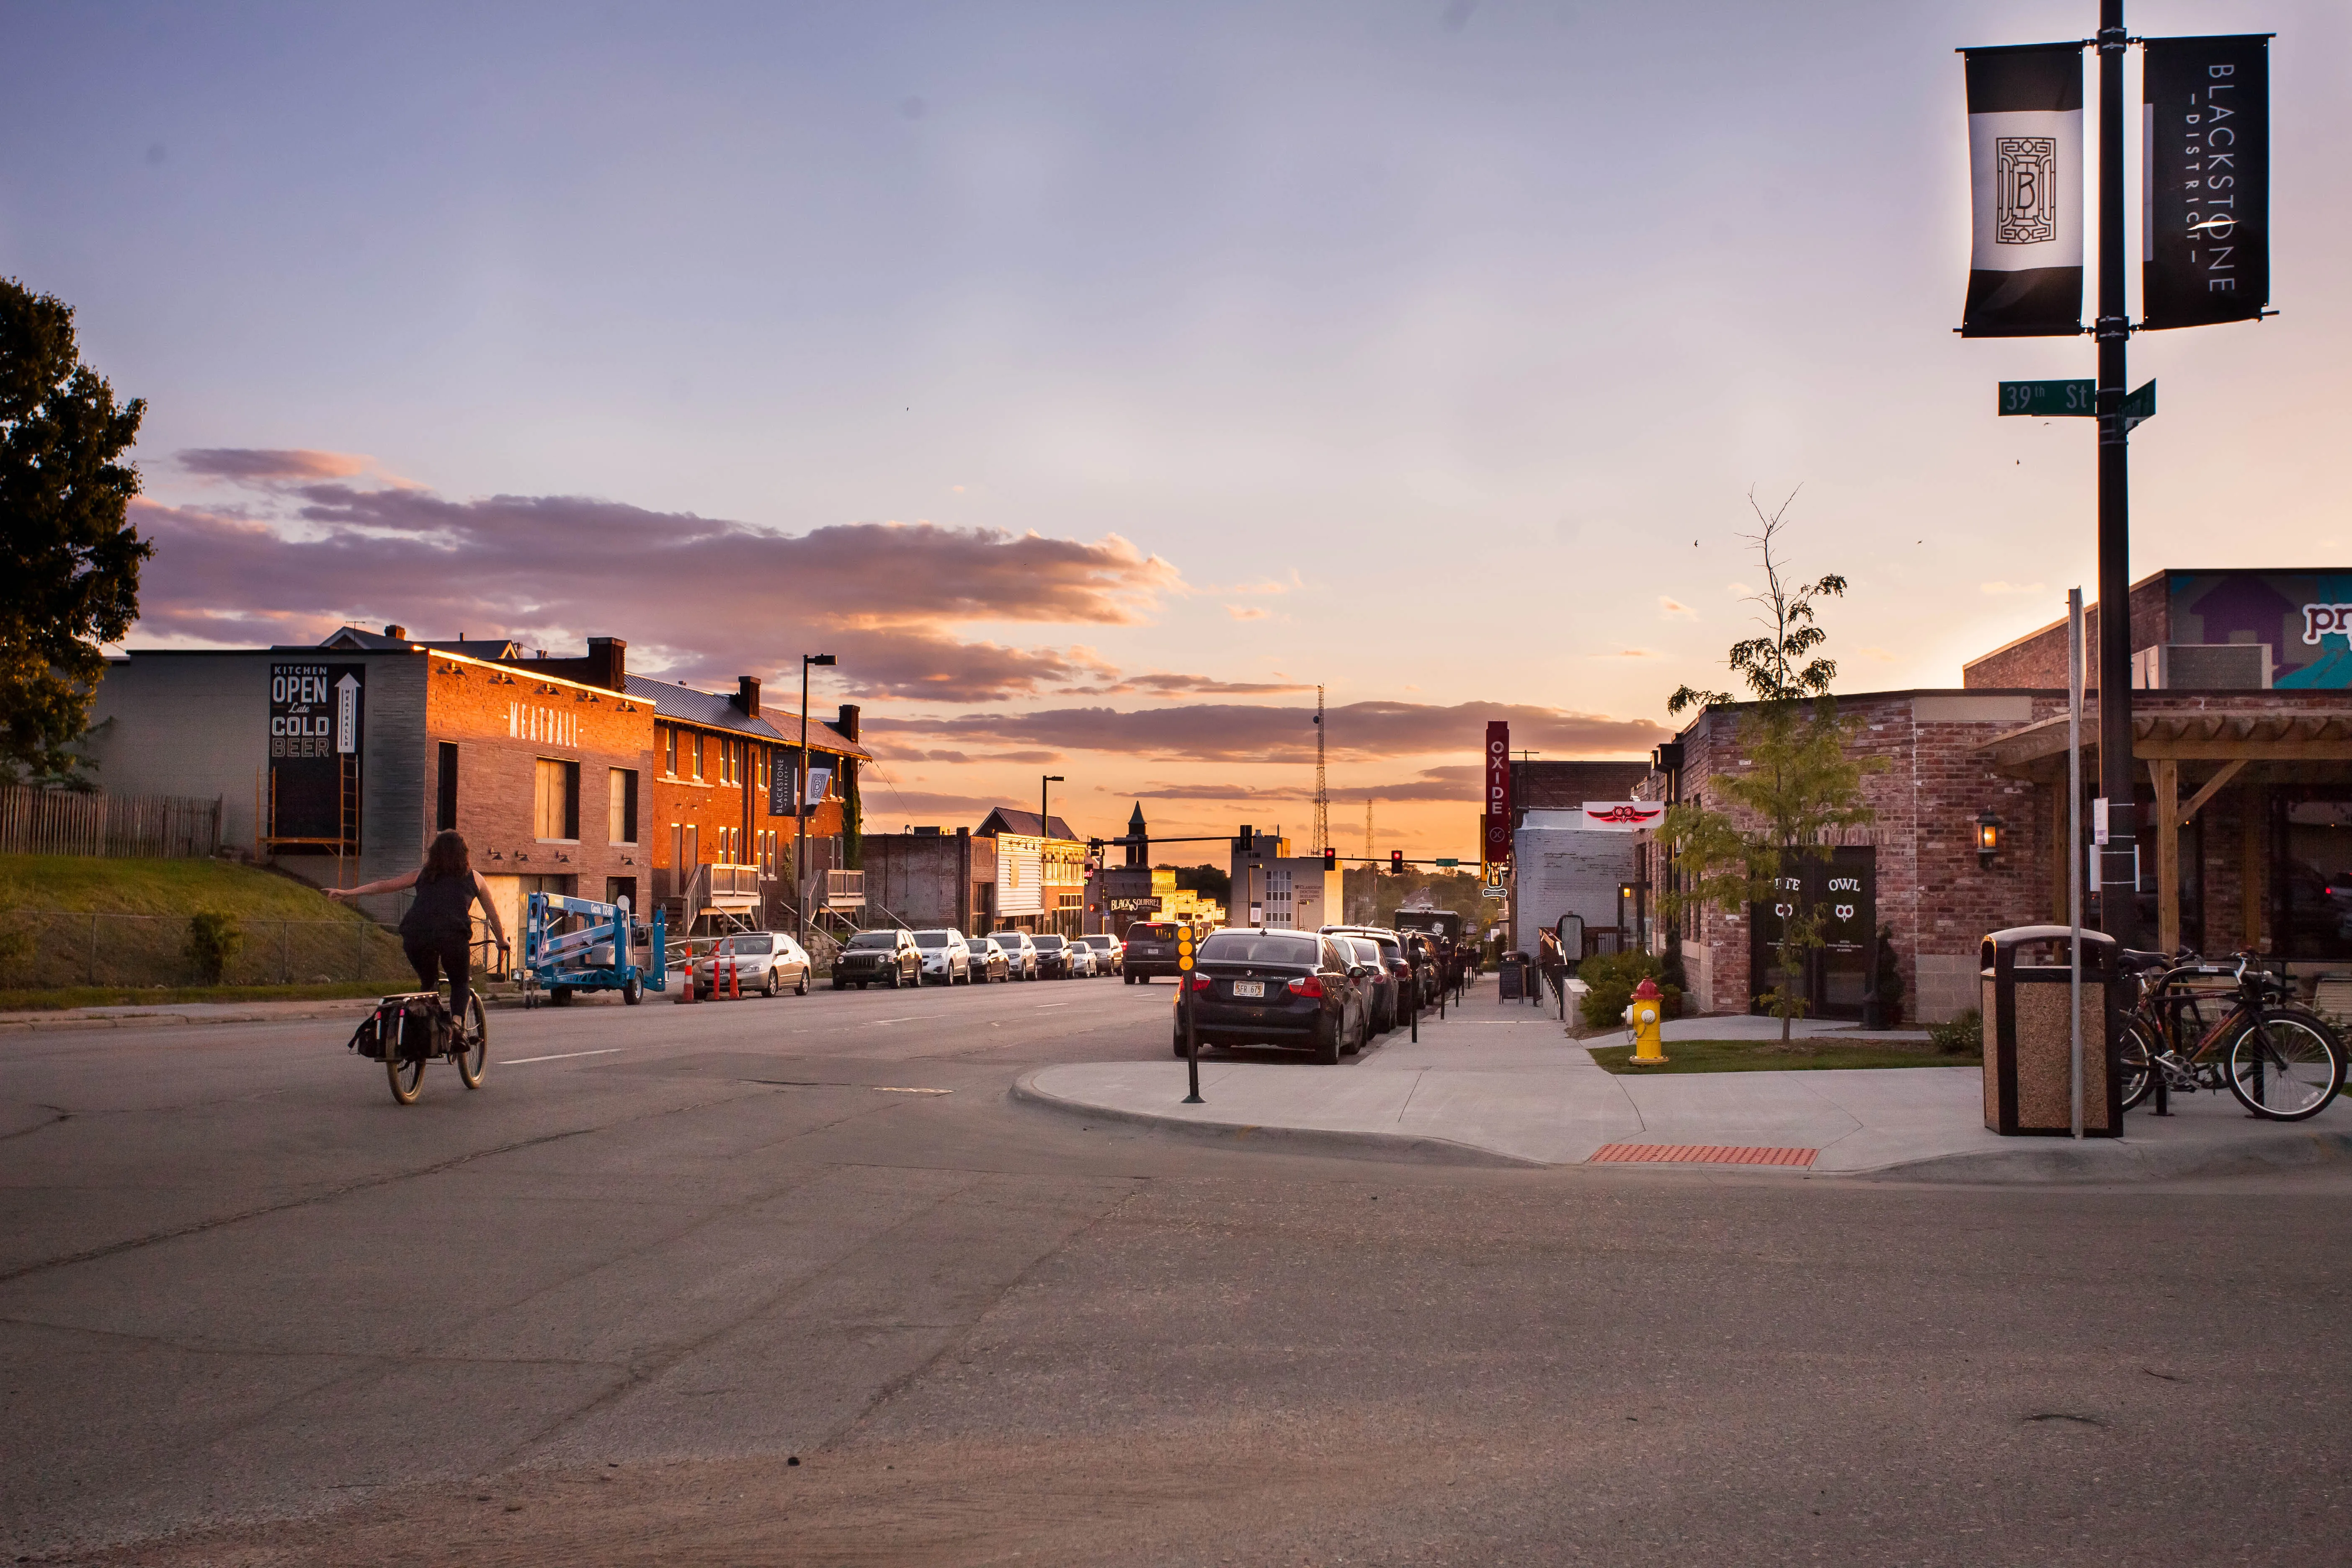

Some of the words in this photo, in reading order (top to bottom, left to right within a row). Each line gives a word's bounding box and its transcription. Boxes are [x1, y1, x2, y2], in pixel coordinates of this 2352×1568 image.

[2185, 113, 2200, 240] DISTRICT
[2208, 64, 2236, 292] BLACKSTONE
[2006, 386, 2045, 411] 39th
[2066, 384, 2087, 409] St
[2307, 608, 2352, 640] pr
[274, 666, 327, 675] KITCHEN
[273, 676, 327, 703] OPEN
[288, 701, 310, 713] Late
[272, 716, 329, 736] COLD
[271, 737, 329, 758] BEER
[1491, 740, 1504, 815] OXIDE
[1828, 878, 1860, 892] OWL
[1111, 899, 1130, 911] BLACK
[1133, 898, 1161, 908] SQUIRREL
